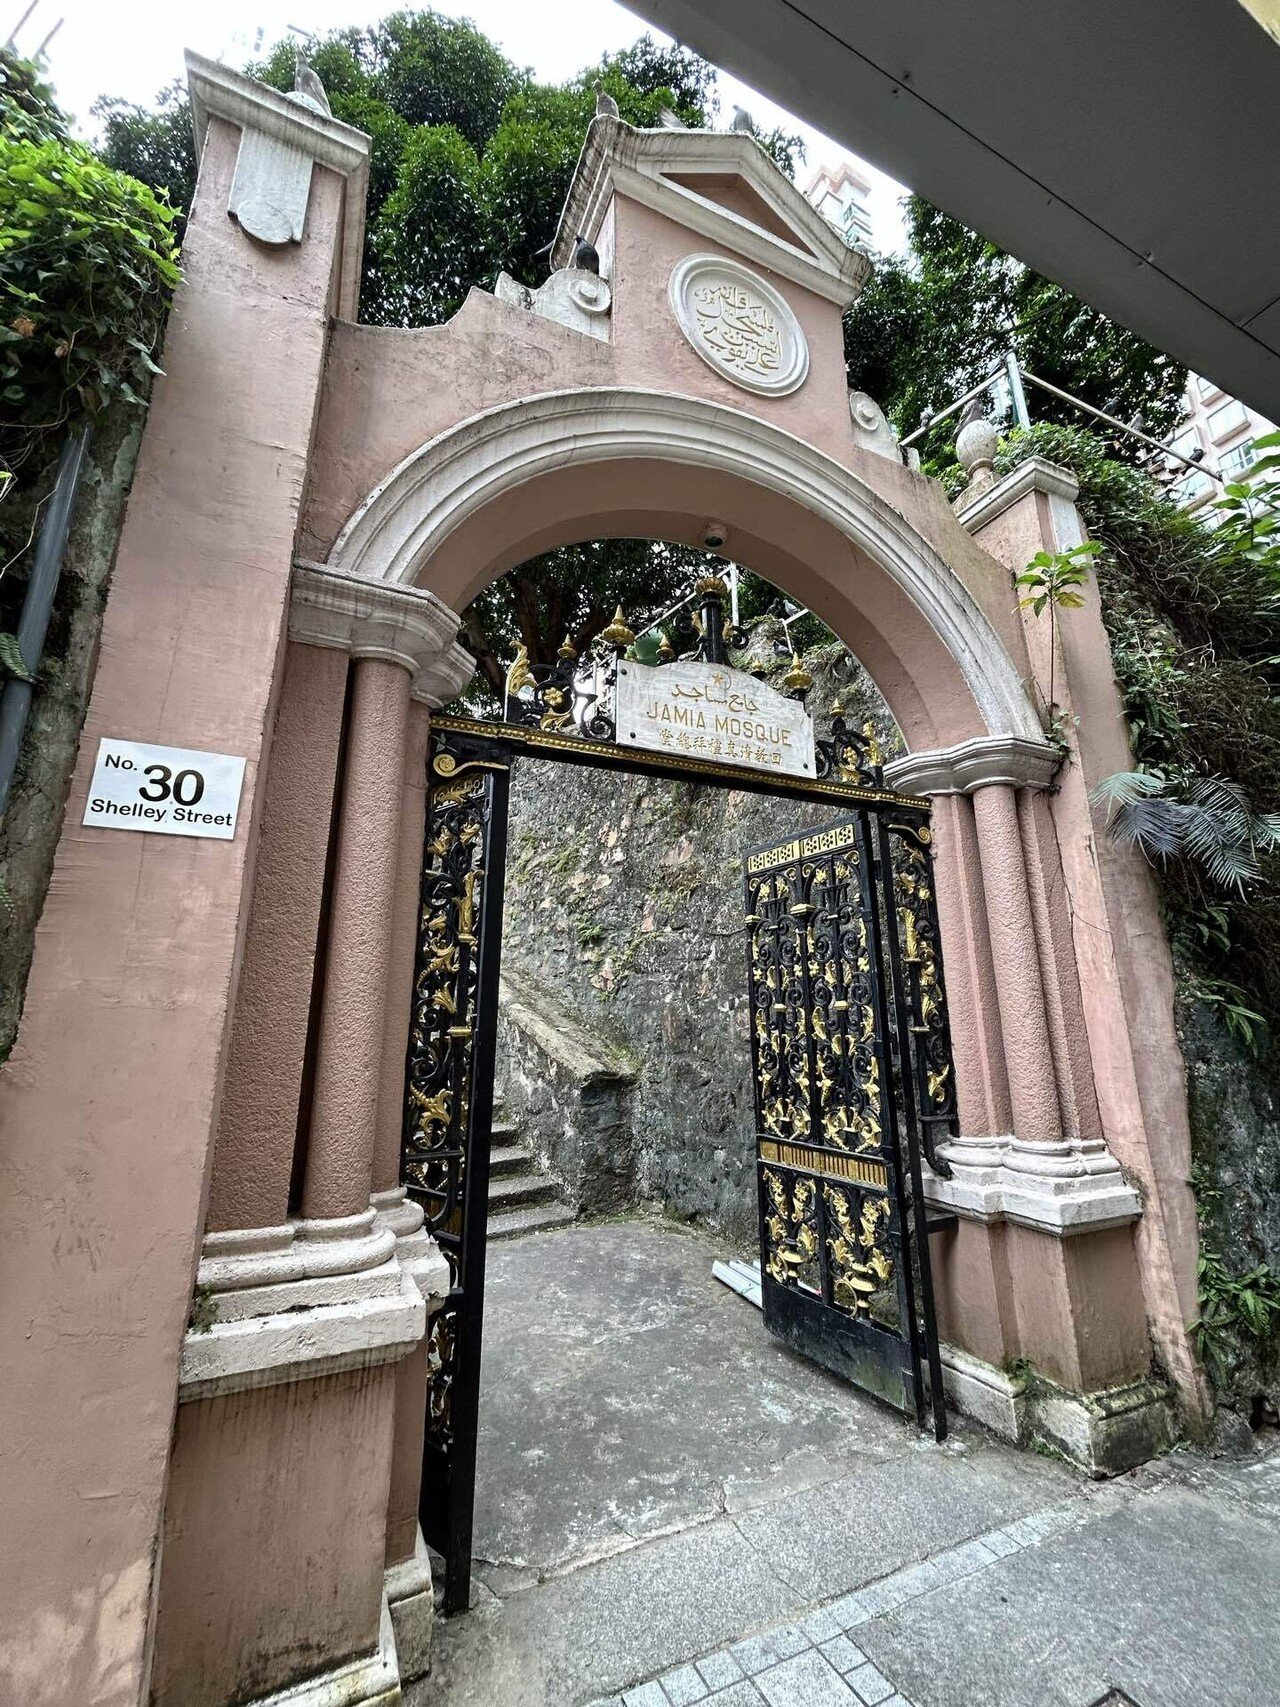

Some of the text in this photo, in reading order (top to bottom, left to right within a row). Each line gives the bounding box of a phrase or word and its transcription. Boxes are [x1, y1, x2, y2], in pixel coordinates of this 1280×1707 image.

[647, 701, 792, 747] JAMIA MOSQUE
[104, 753, 205, 807] No. 30
[90, 798, 233, 827] Shelley Street
